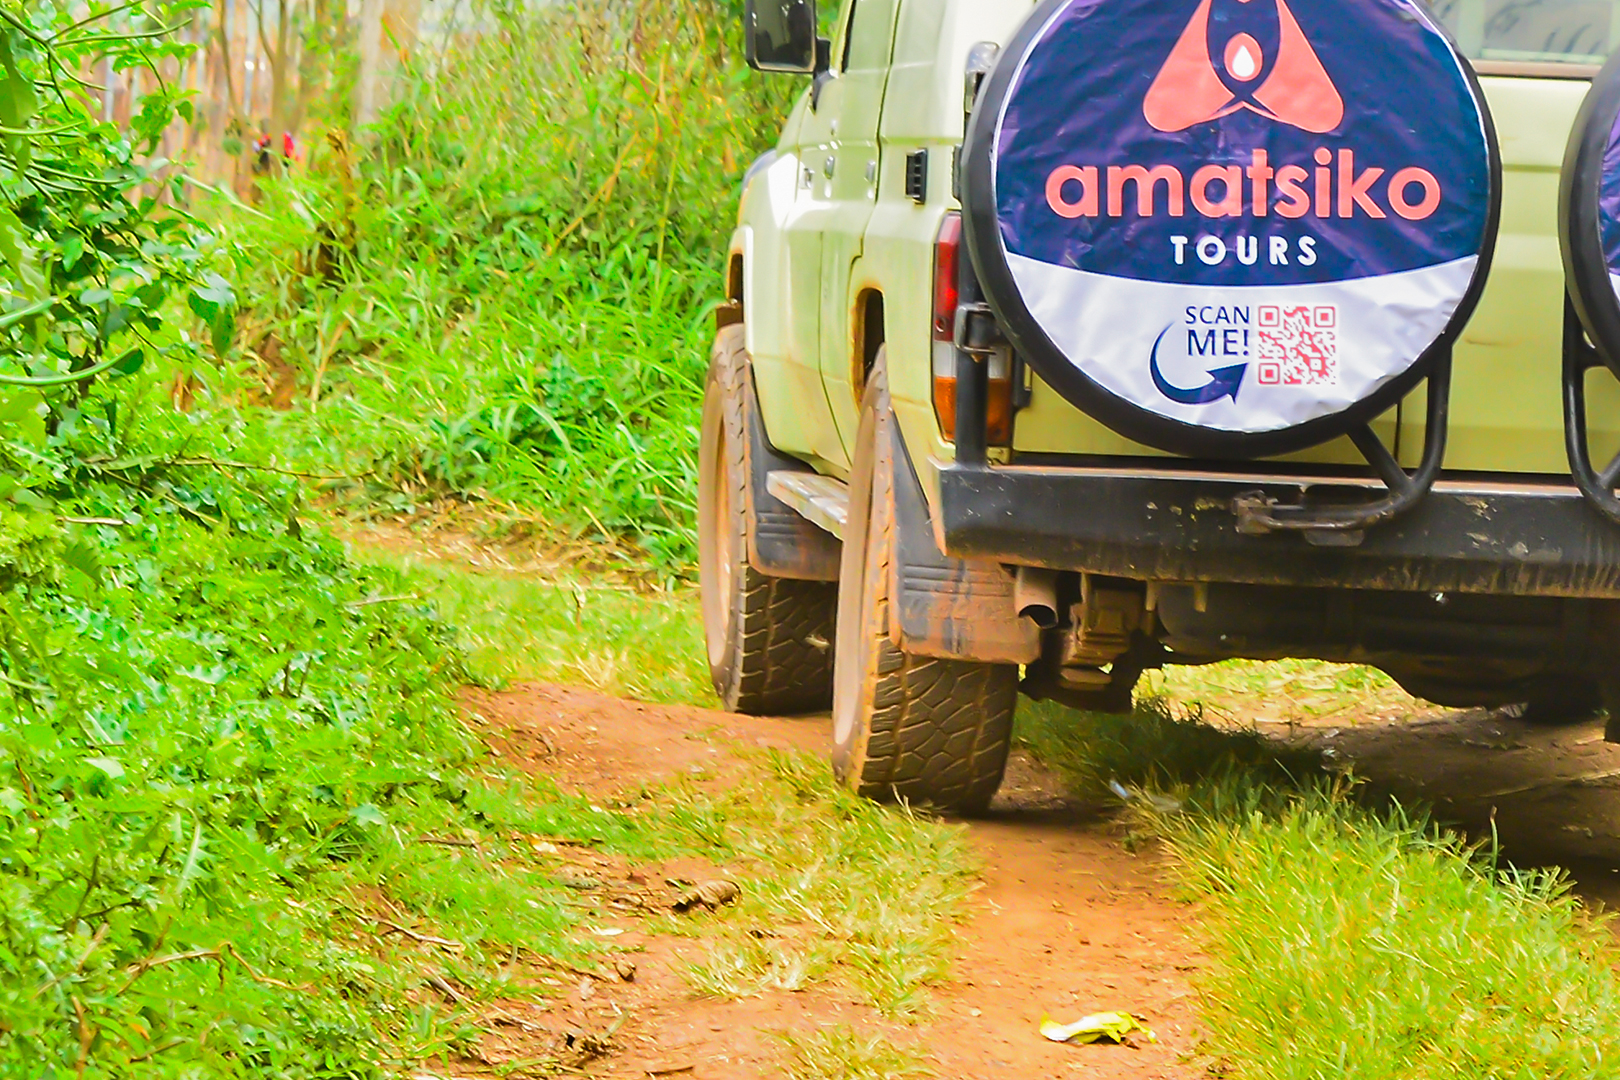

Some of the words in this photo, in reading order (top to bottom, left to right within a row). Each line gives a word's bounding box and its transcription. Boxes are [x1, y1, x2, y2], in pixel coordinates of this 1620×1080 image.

[1045, 146, 1441, 220] amatsiko
[1170, 235, 1318, 266] TOURS
[1184, 305, 1250, 325] SCAN
[1186, 329, 1250, 357] ME!
